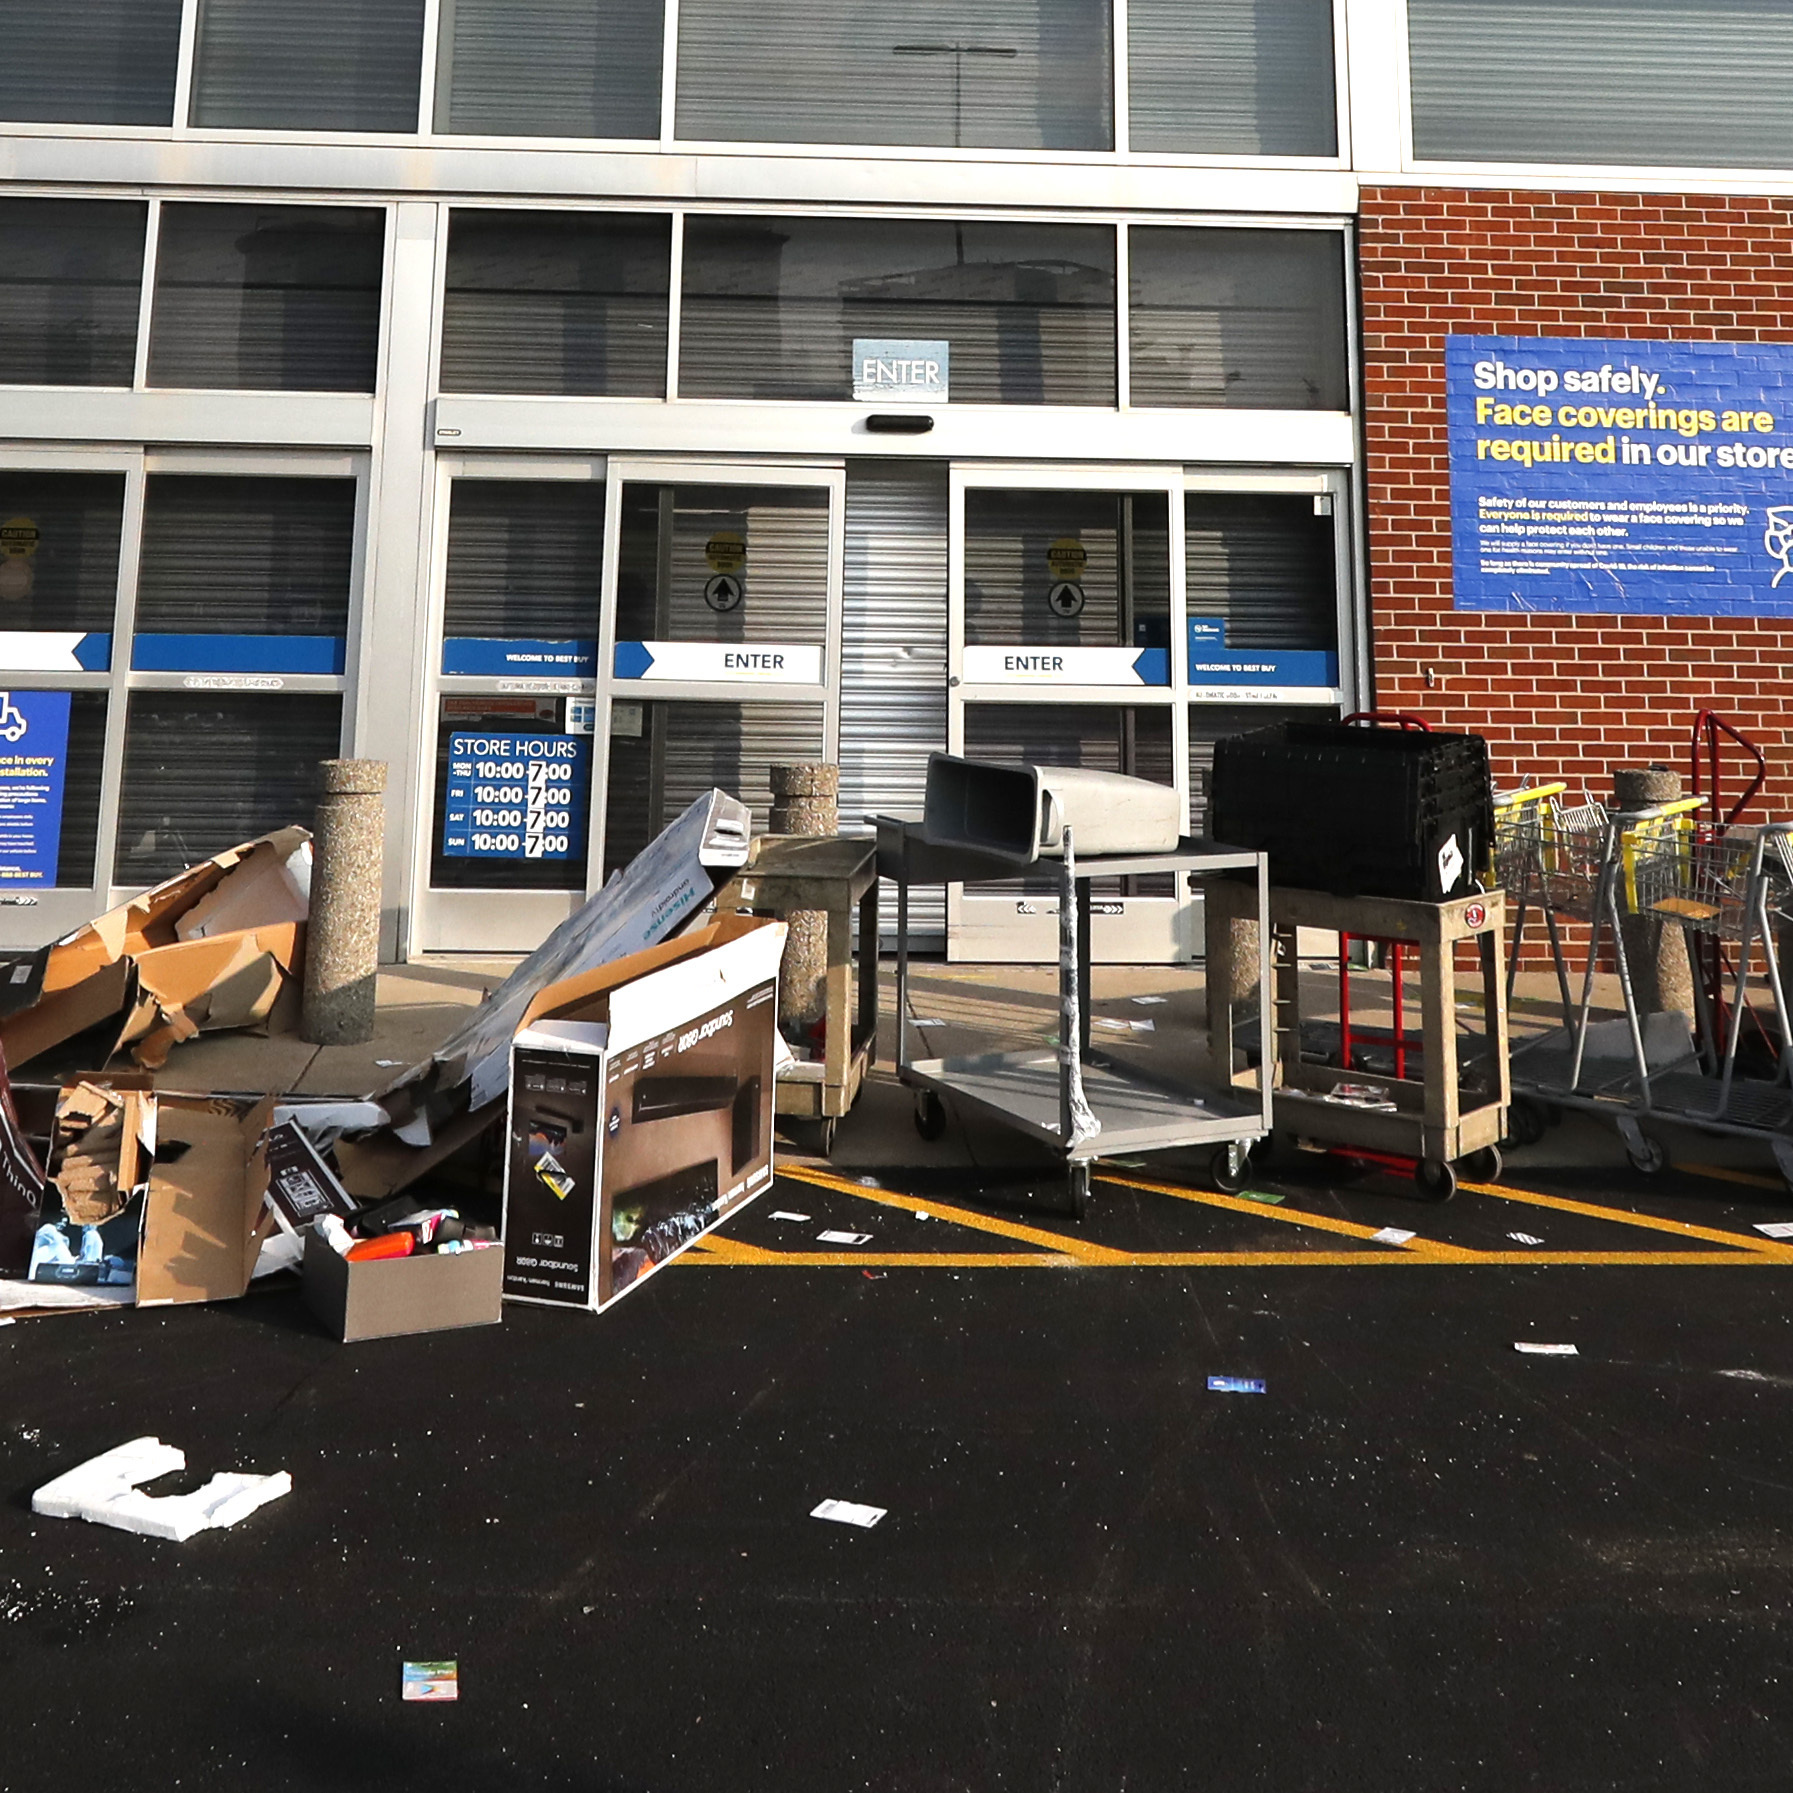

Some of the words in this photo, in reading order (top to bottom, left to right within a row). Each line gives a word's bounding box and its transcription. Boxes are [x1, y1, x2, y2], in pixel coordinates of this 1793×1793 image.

[862, 359, 940, 384] ENTER
[1473, 361, 1558, 397] Shop
[1563, 364, 1666, 400] safely.
[1475, 396, 1553, 426] Face
[1557, 400, 1717, 437] coverings
[1721, 410, 1774, 433] are
[1476, 434, 1616, 468] required
[1621, 436, 1651, 465] in
[1656, 443, 1712, 466] our
[1478, 496, 1514, 509] Safety
[1515, 497, 1527, 508] of
[1528, 500, 1547, 509] our
[1548, 500, 1606, 510] customers
[1607, 500, 1628, 511] and
[1629, 501, 1687, 514] employees
[1689, 502, 1699, 513] is
[1700, 504, 1707, 513] a
[1707, 502, 1750, 516] priority.
[1479, 508, 1530, 521] Everyone
[1531, 510, 1540, 521] is
[1541, 511, 1588, 523] required
[1589, 513, 1602, 522] to
[1602, 514, 1629, 523] wear
[1630, 515, 1638, 523] a
[1638, 513, 1663, 524] face
[1664, 514, 1712, 527] covering
[1713, 517, 1726, 525] so
[1727, 517, 1744, 525] we
[1479, 524, 1500, 533] can
[1501, 523, 1525, 536] help
[1526, 525, 1568, 536] protect
[1569, 525, 1595, 535] each
[1596, 525, 1629, 536] other.
[506, 654, 542, 662] WELCOME
[544, 655, 554, 663] TO
[555, 655, 573, 663] BEST
[724, 653, 785, 669] ENTER
[1004, 656, 1064, 671] ENTER
[1195, 664, 1231, 672] WELCOME
[1231, 664, 1242, 672] TO
[1243, 664, 1261, 672] BEST
[453, 738, 511, 756] STORE
[516, 740, 577, 758] HOURS
[14, 755, 24, 765] in
[25, 757, 54, 768] every
[452, 762, 472, 770] MON
[451, 789, 464, 797] FRI
[448, 838, 465, 846] SUN
[643, 887, 697, 941] Hisense
[697, 1009, 735, 1040] Soundbar
[3, 1151, 37, 1207] ThinQ
[538, 1259, 579, 1273] Soundbar
